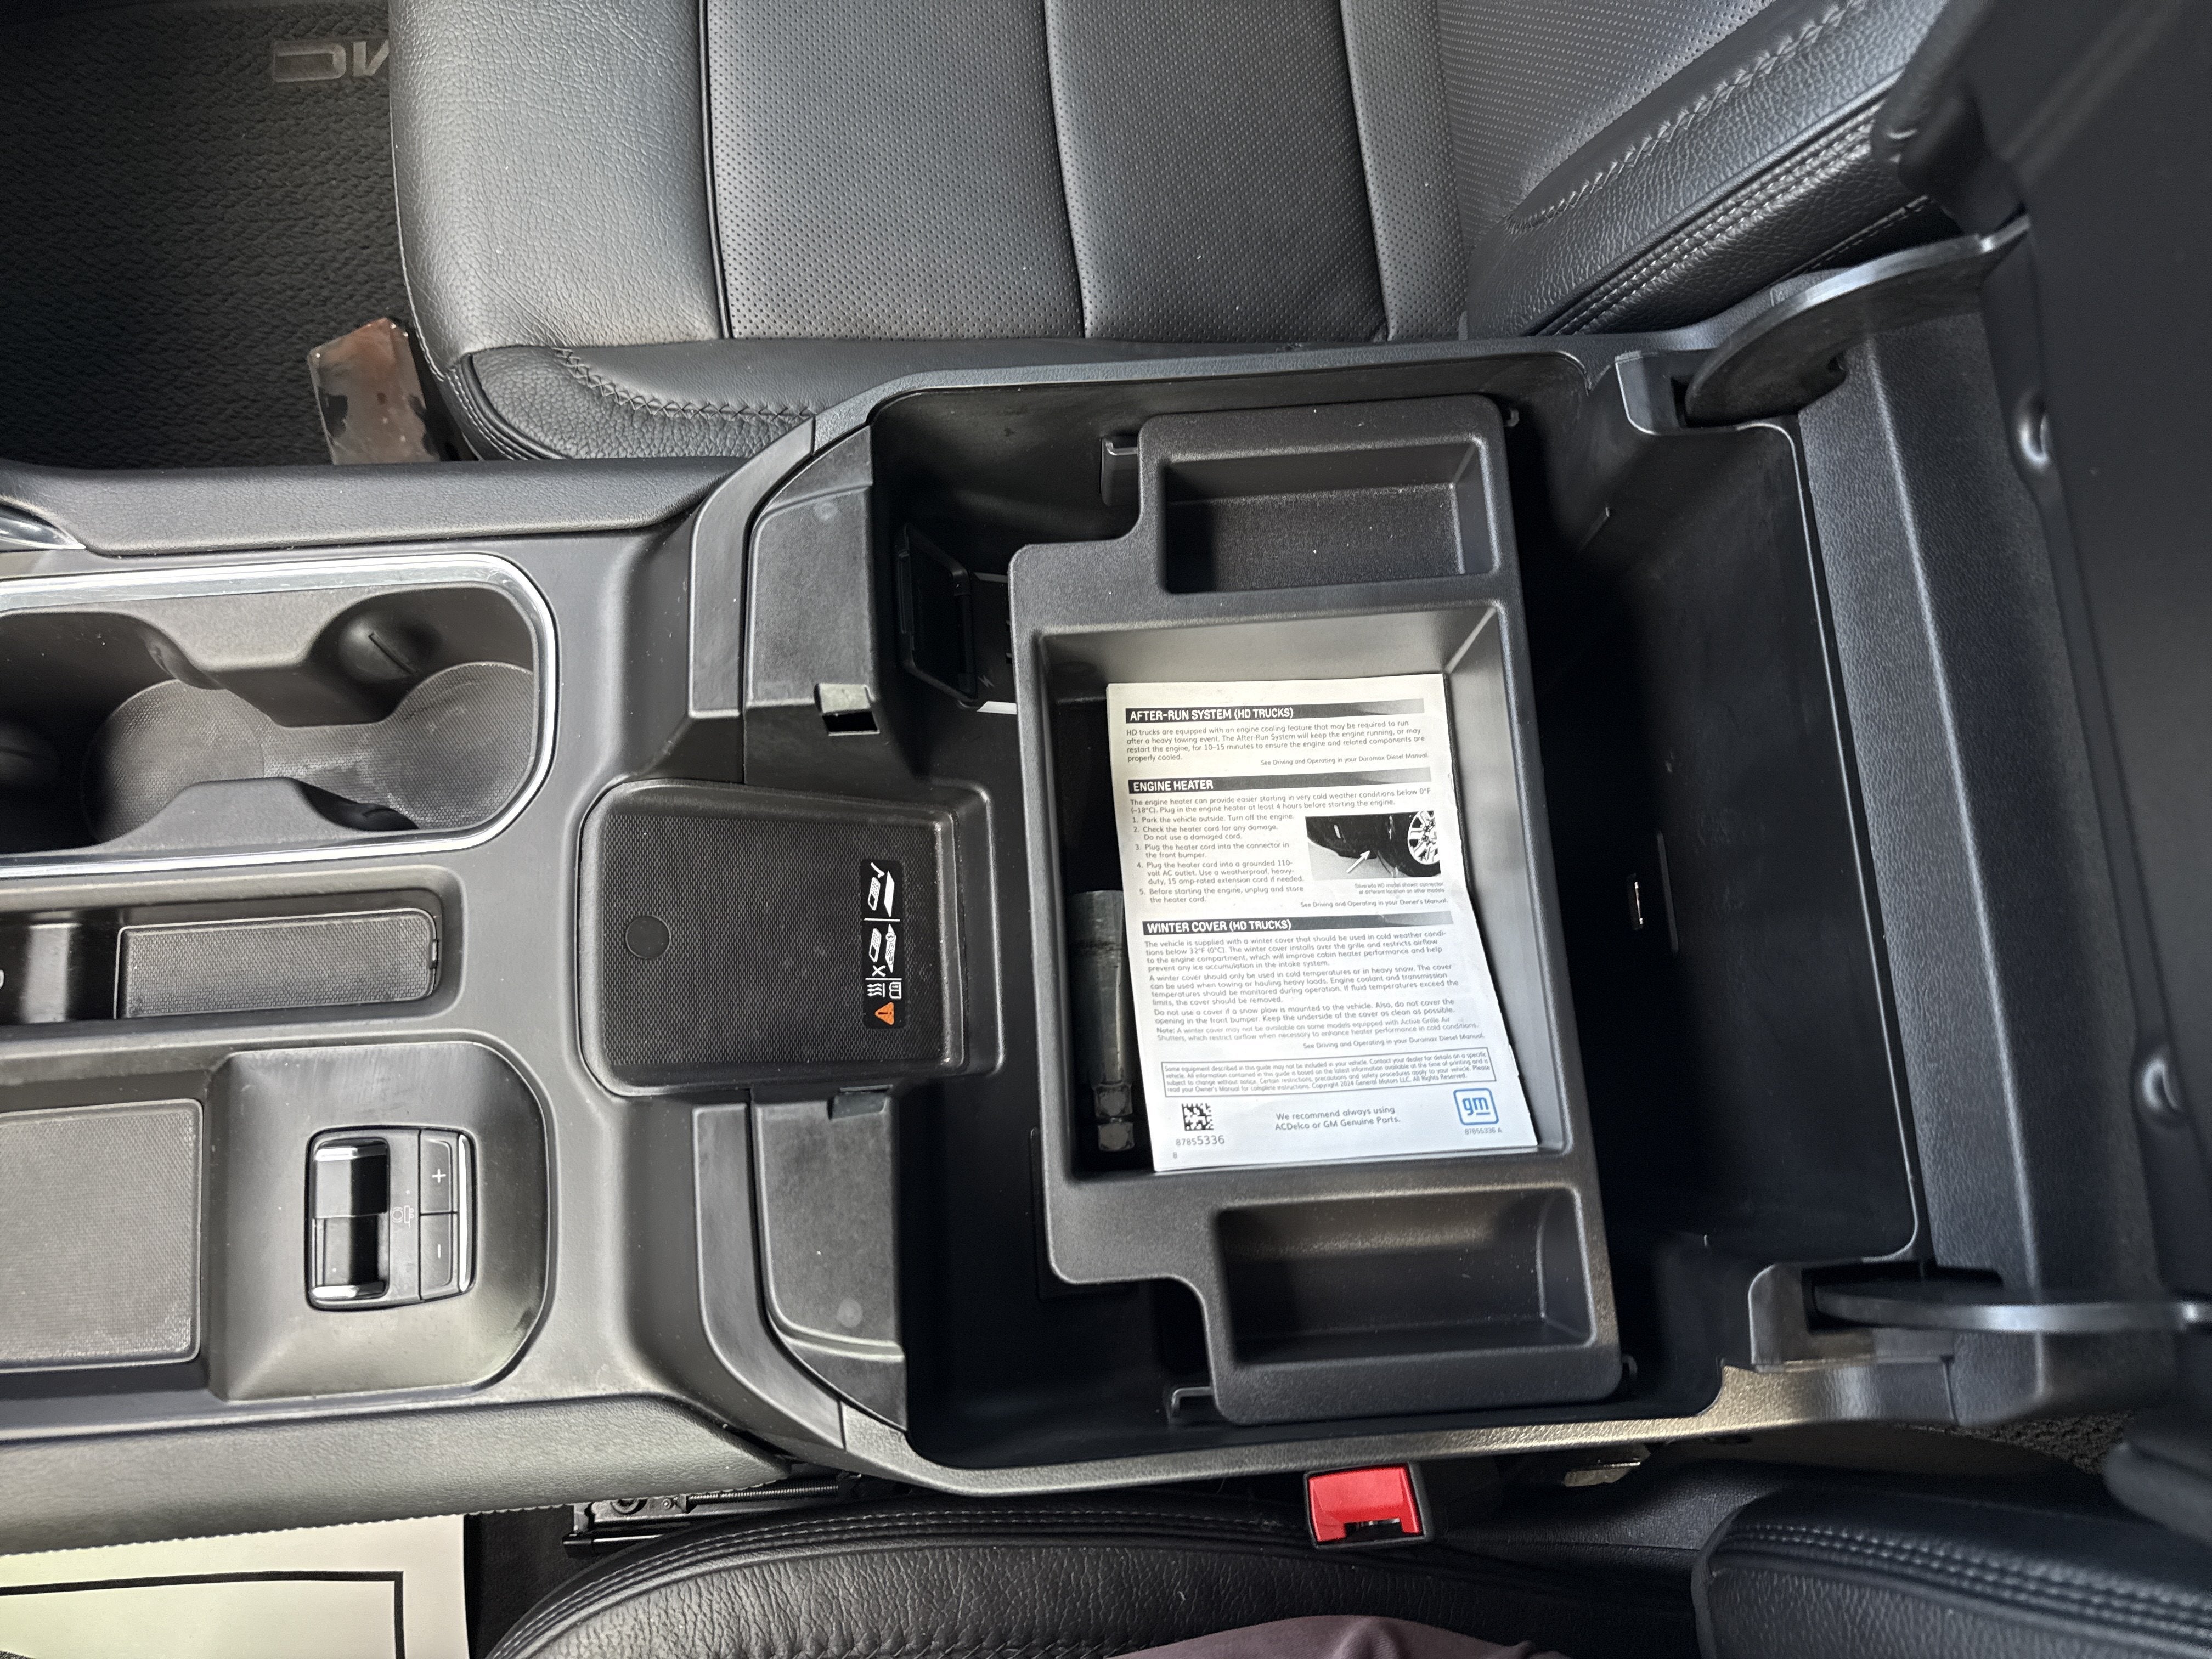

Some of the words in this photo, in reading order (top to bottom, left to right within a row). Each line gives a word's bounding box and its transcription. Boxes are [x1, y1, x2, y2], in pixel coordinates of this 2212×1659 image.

[1130, 710, 1189, 721] AFTER-RUN
[1191, 709, 1232, 721] SYSTEM
[1234, 708, 1251, 721] (HD
[1252, 707, 1293, 720] TRUCKS)
[1175, 727, 1206, 736] equipped
[1357, 720, 1386, 729] required
[1271, 733, 1295, 741] System
[1127, 754, 1155, 763] properly
[1133, 781, 1171, 791] ENGINE
[1173, 779, 1213, 790] HEATER
[1144, 843, 1160, 851] Plug
[1147, 922, 1189, 933] WINTER
[1191, 921, 1227, 932] COVER
[1229, 921, 1247, 932] (HD
[1248, 919, 1291, 931] TRUCKS)
[1291, 1110, 1340, 1119] recommend
[1342, 1108, 1371, 1117] always
[1373, 1106, 1395, 1115] using
[1462, 1097, 1489, 1116] gm
[1323, 1120, 1338, 1128] GM
[1176, 1135, 1225, 1146] 87855336
